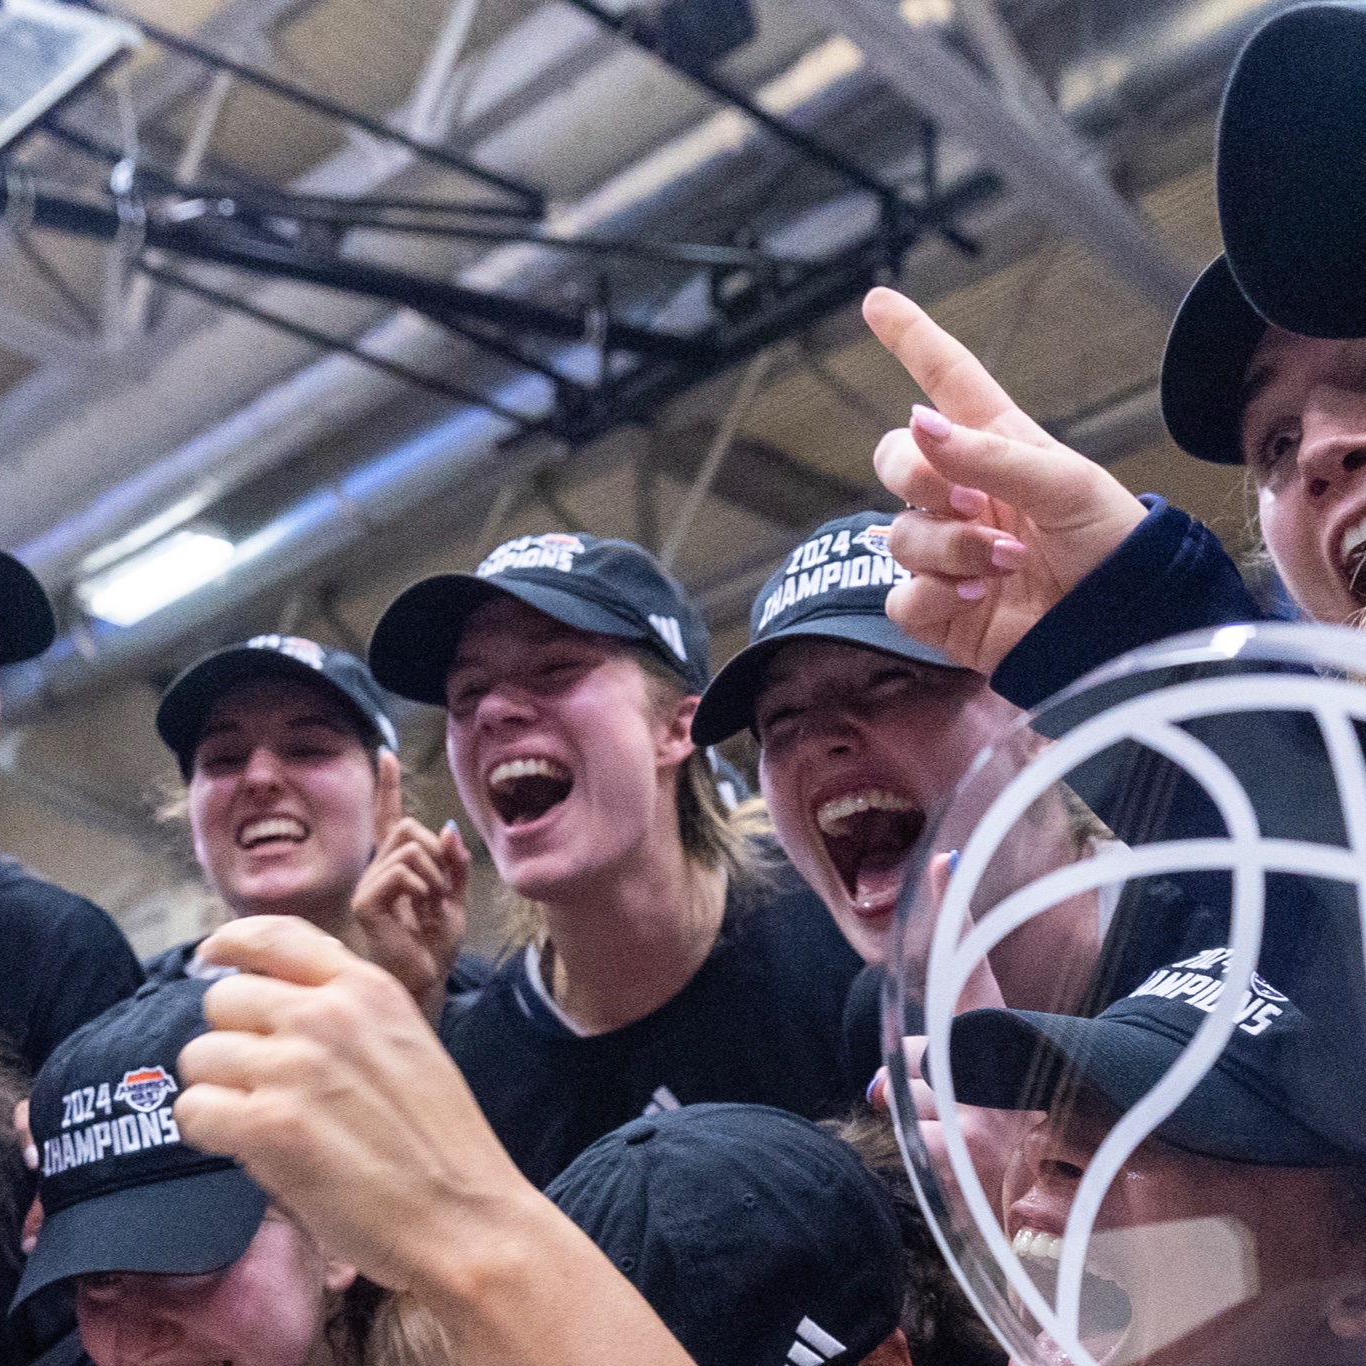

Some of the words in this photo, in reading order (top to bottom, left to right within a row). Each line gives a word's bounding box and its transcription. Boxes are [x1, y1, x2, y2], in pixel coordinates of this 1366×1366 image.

[785, 529, 851, 576] 2024
[61, 1082, 113, 1129] 2024
[41, 1106, 181, 1178] CHAMPIONS
